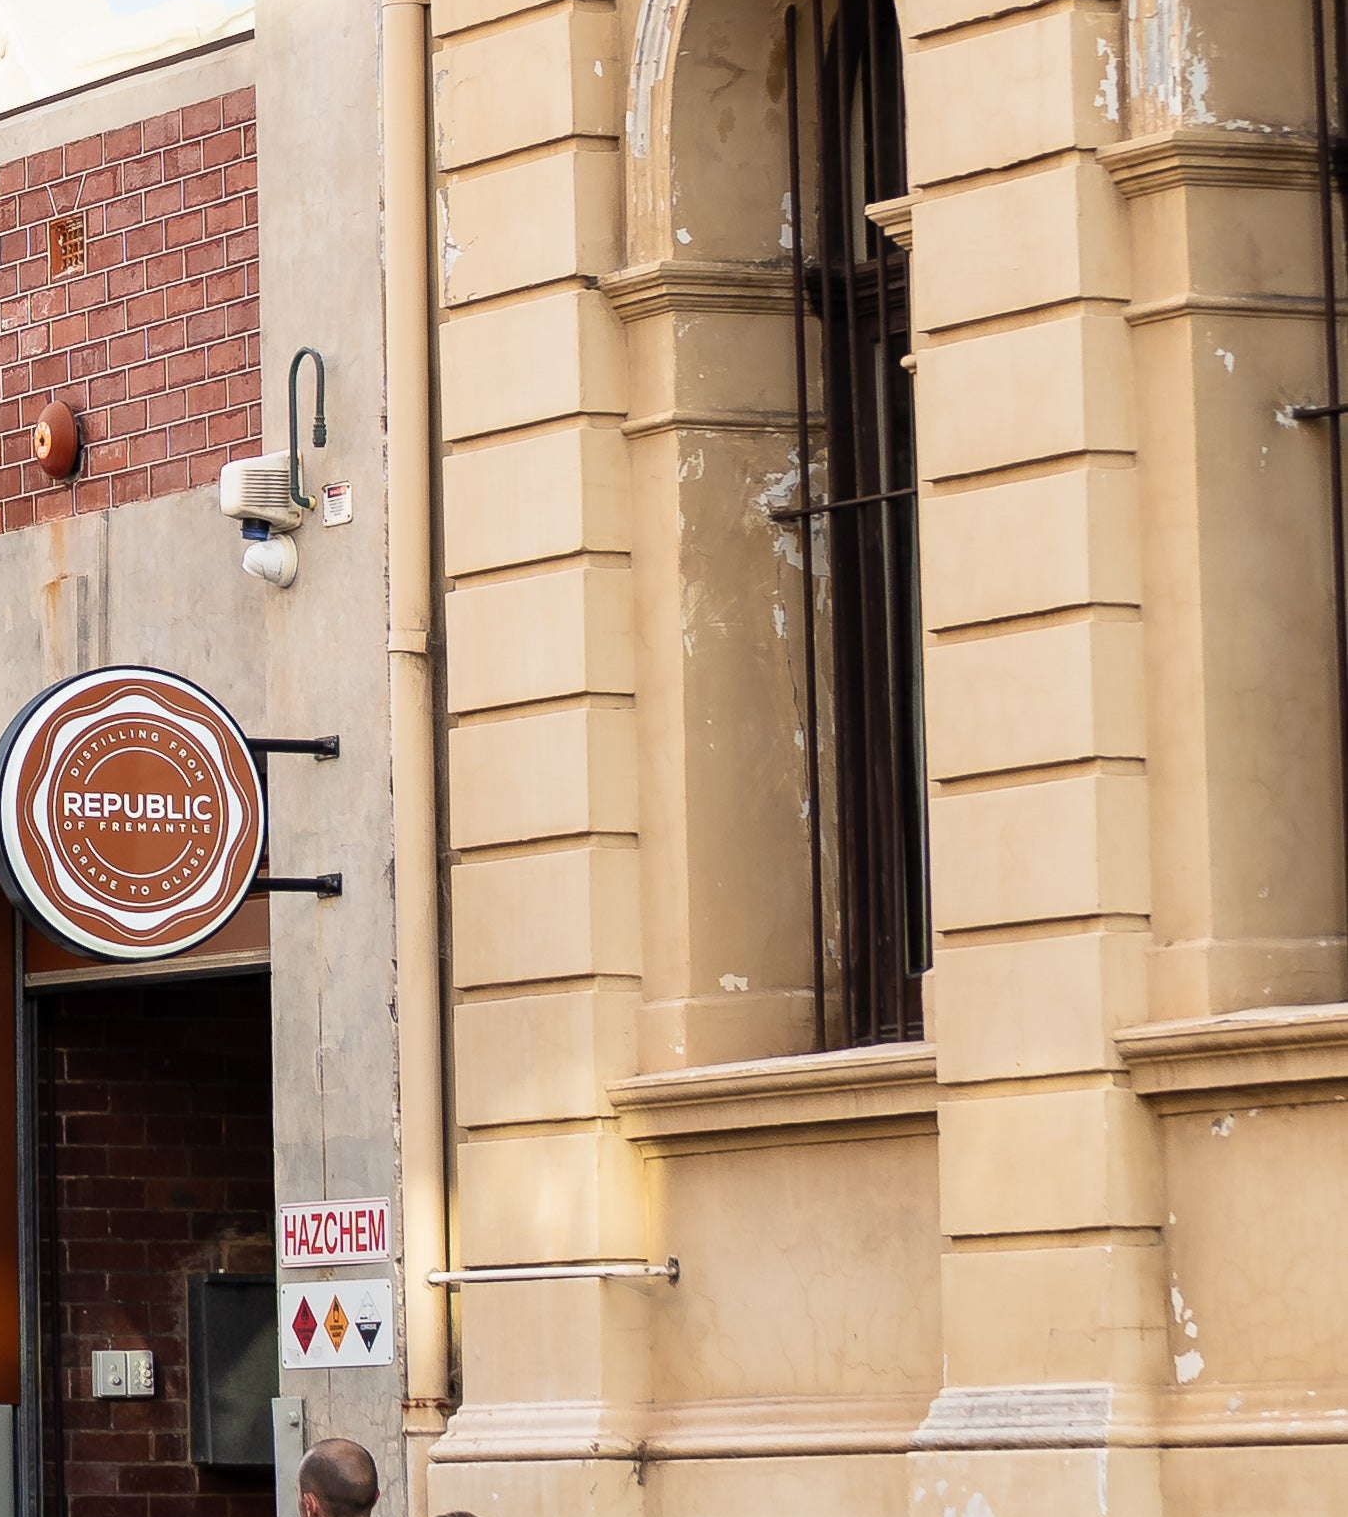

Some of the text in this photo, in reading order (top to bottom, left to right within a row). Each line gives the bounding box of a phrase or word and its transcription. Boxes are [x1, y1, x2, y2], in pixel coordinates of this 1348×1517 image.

[69, 728, 205, 782] DISTILLING FROM
[62, 791, 213, 821] REPUBLIC
[63, 820, 212, 834] OF FREMANTLE
[71, 844, 205, 896] GRAPE TO GLASS
[284, 1209, 386, 1256] HAZCHEM
